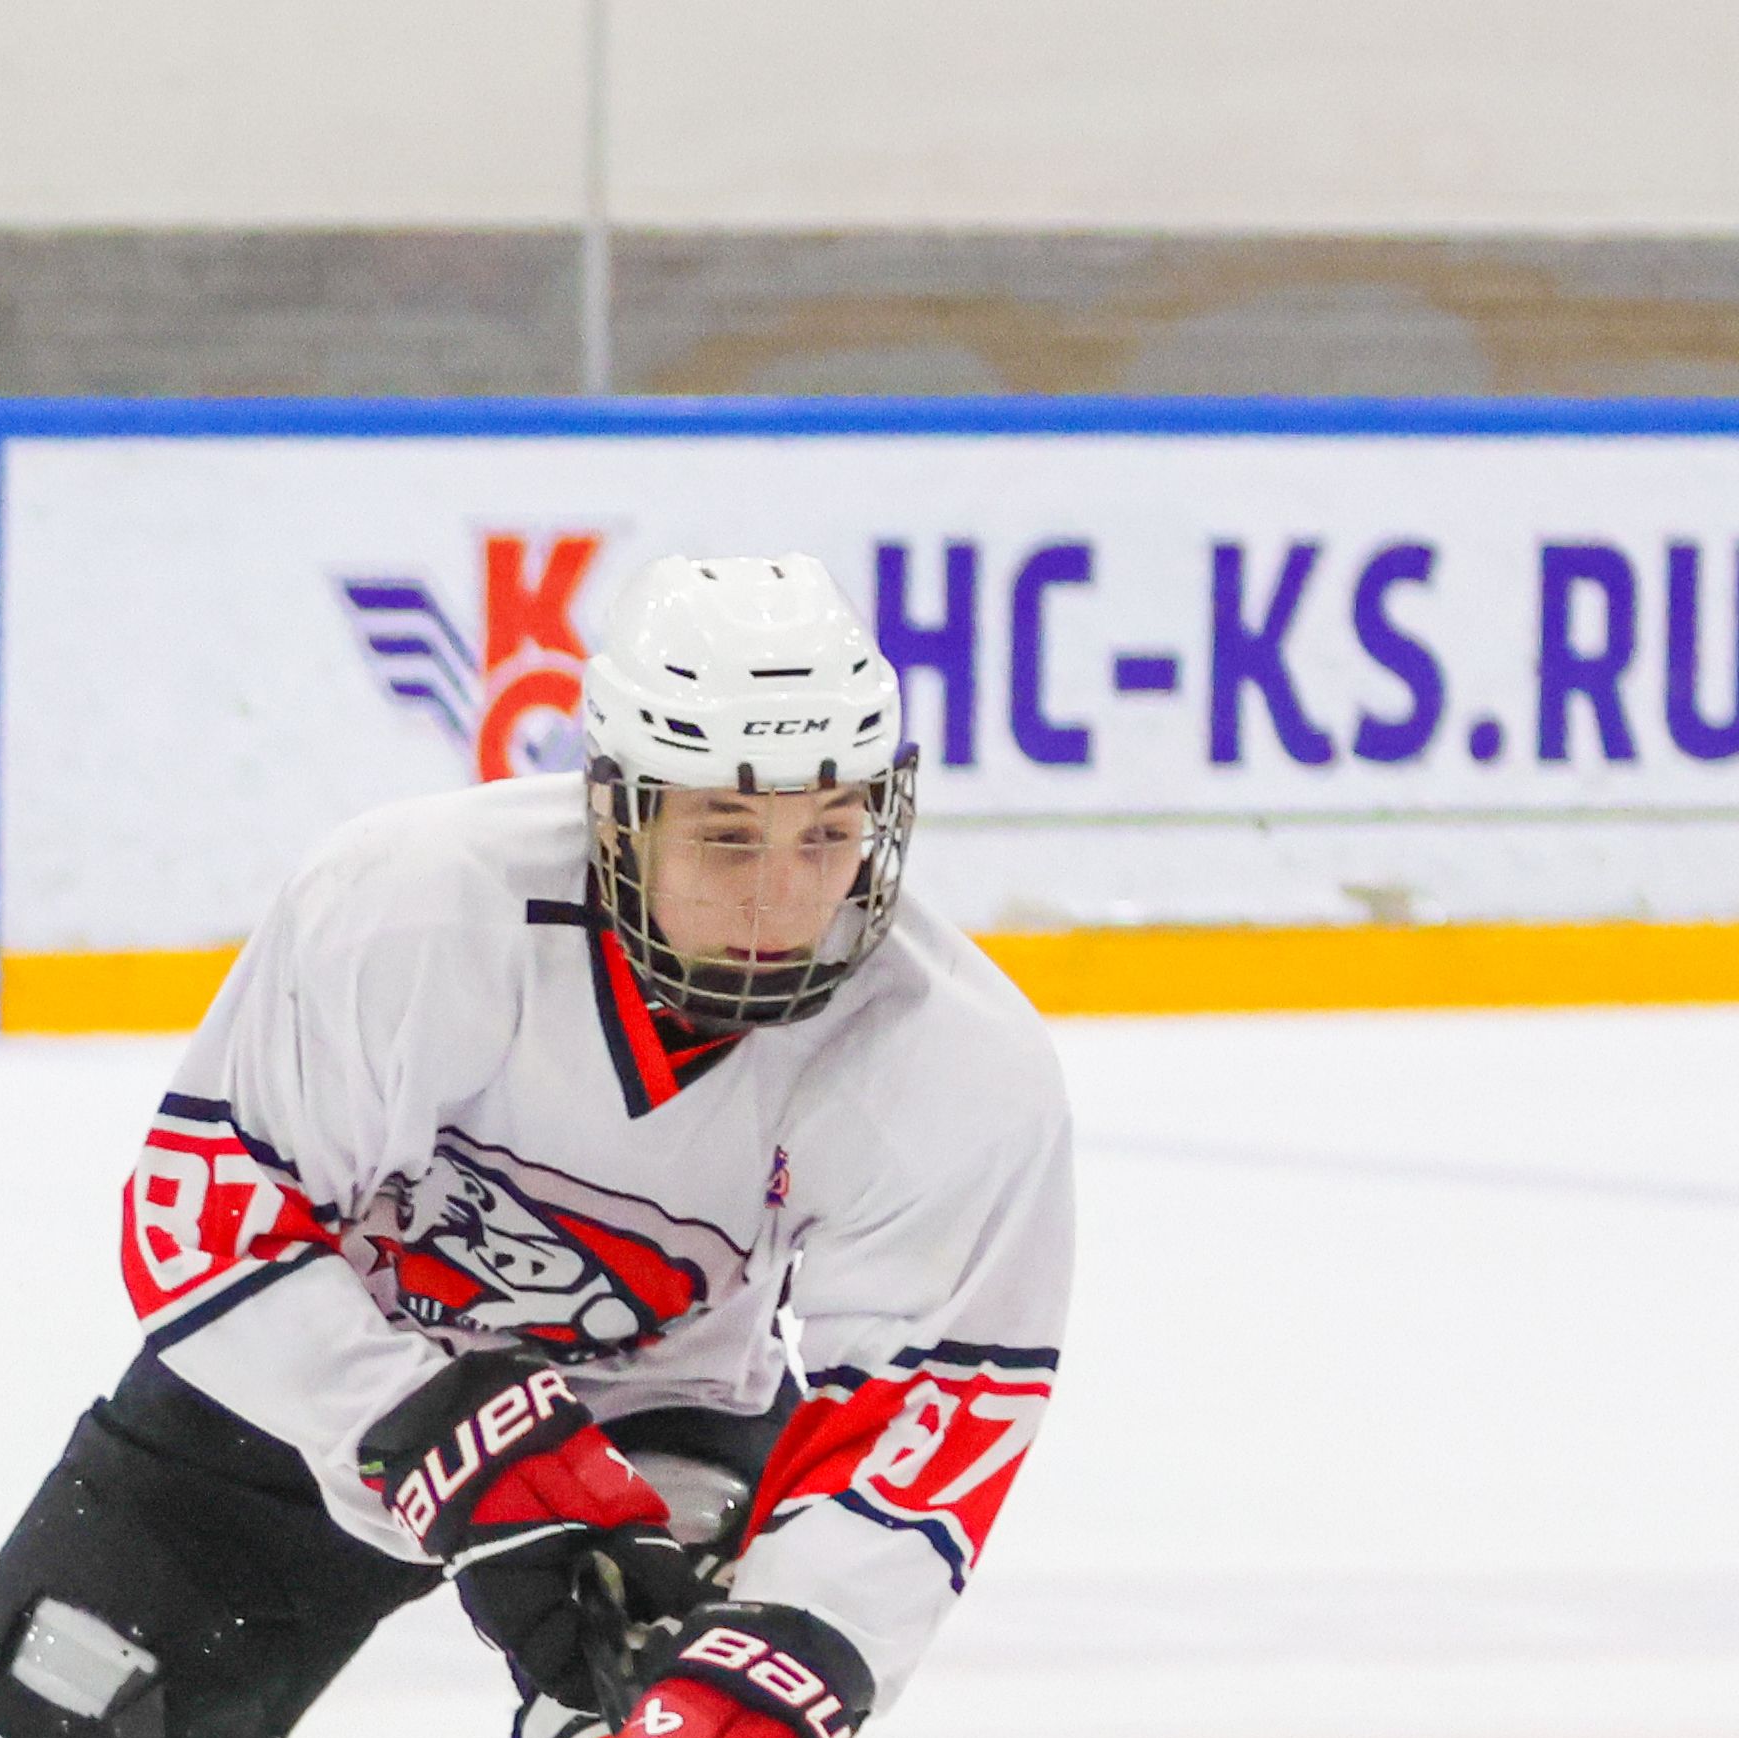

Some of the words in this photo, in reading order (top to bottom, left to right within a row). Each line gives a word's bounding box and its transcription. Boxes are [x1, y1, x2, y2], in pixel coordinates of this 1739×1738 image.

[743, 716, 832, 736] CCM
[134, 1145, 287, 1293] 87
[850, 1379, 1049, 1506] 87
